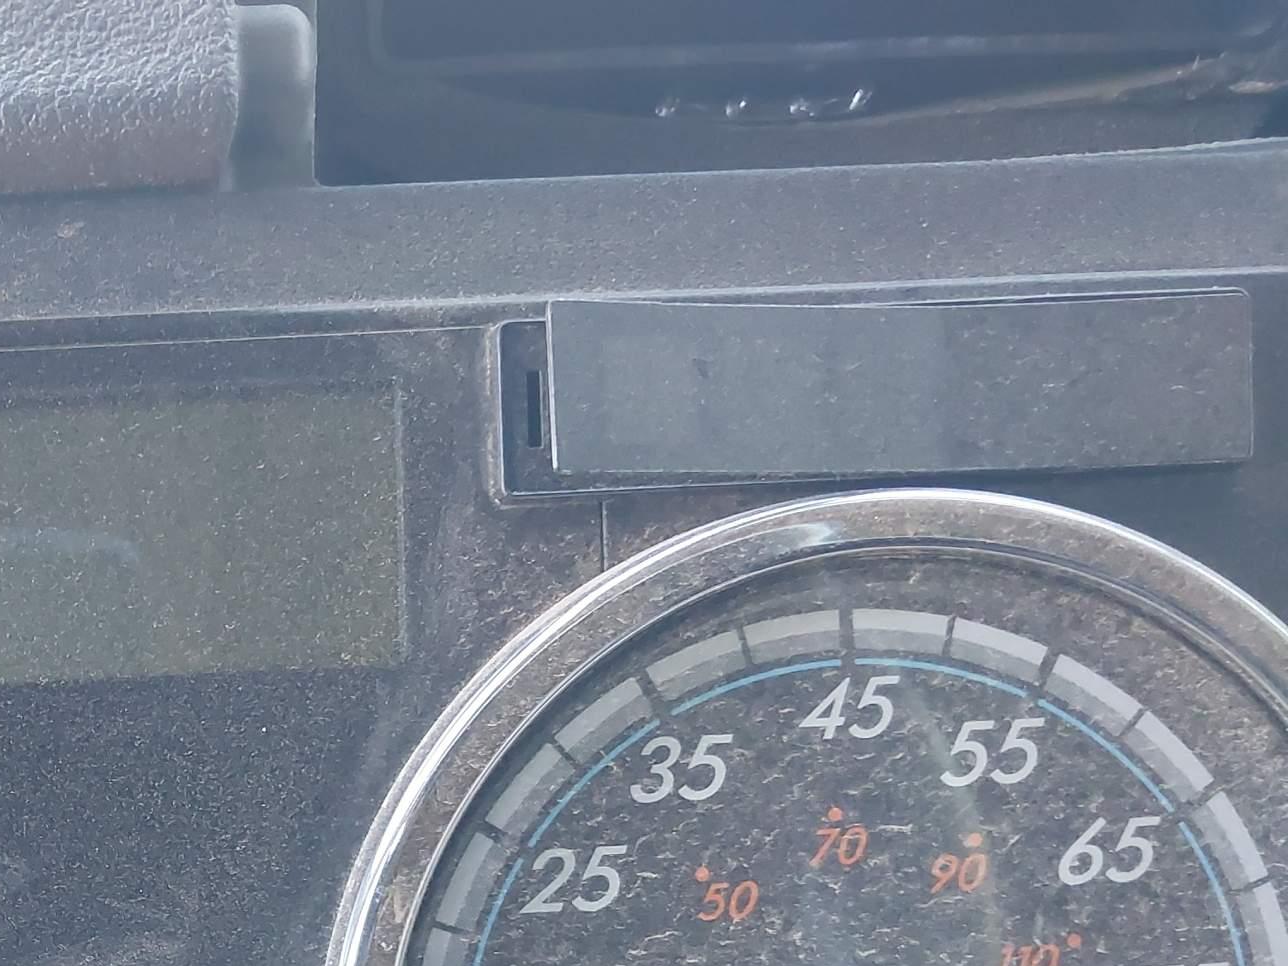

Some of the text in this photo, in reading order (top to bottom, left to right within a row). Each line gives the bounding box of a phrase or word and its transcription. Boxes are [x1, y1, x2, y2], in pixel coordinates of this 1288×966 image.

[799, 676, 900, 740] 45
[630, 734, 733, 803] 35
[940, 718, 1046, 787] 55
[809, 825, 868, 867] 70
[930, 852, 988, 894] 90
[1058, 815, 1164, 885] 65
[519, 845, 630, 915] 25
[697, 881, 760, 923] 50
